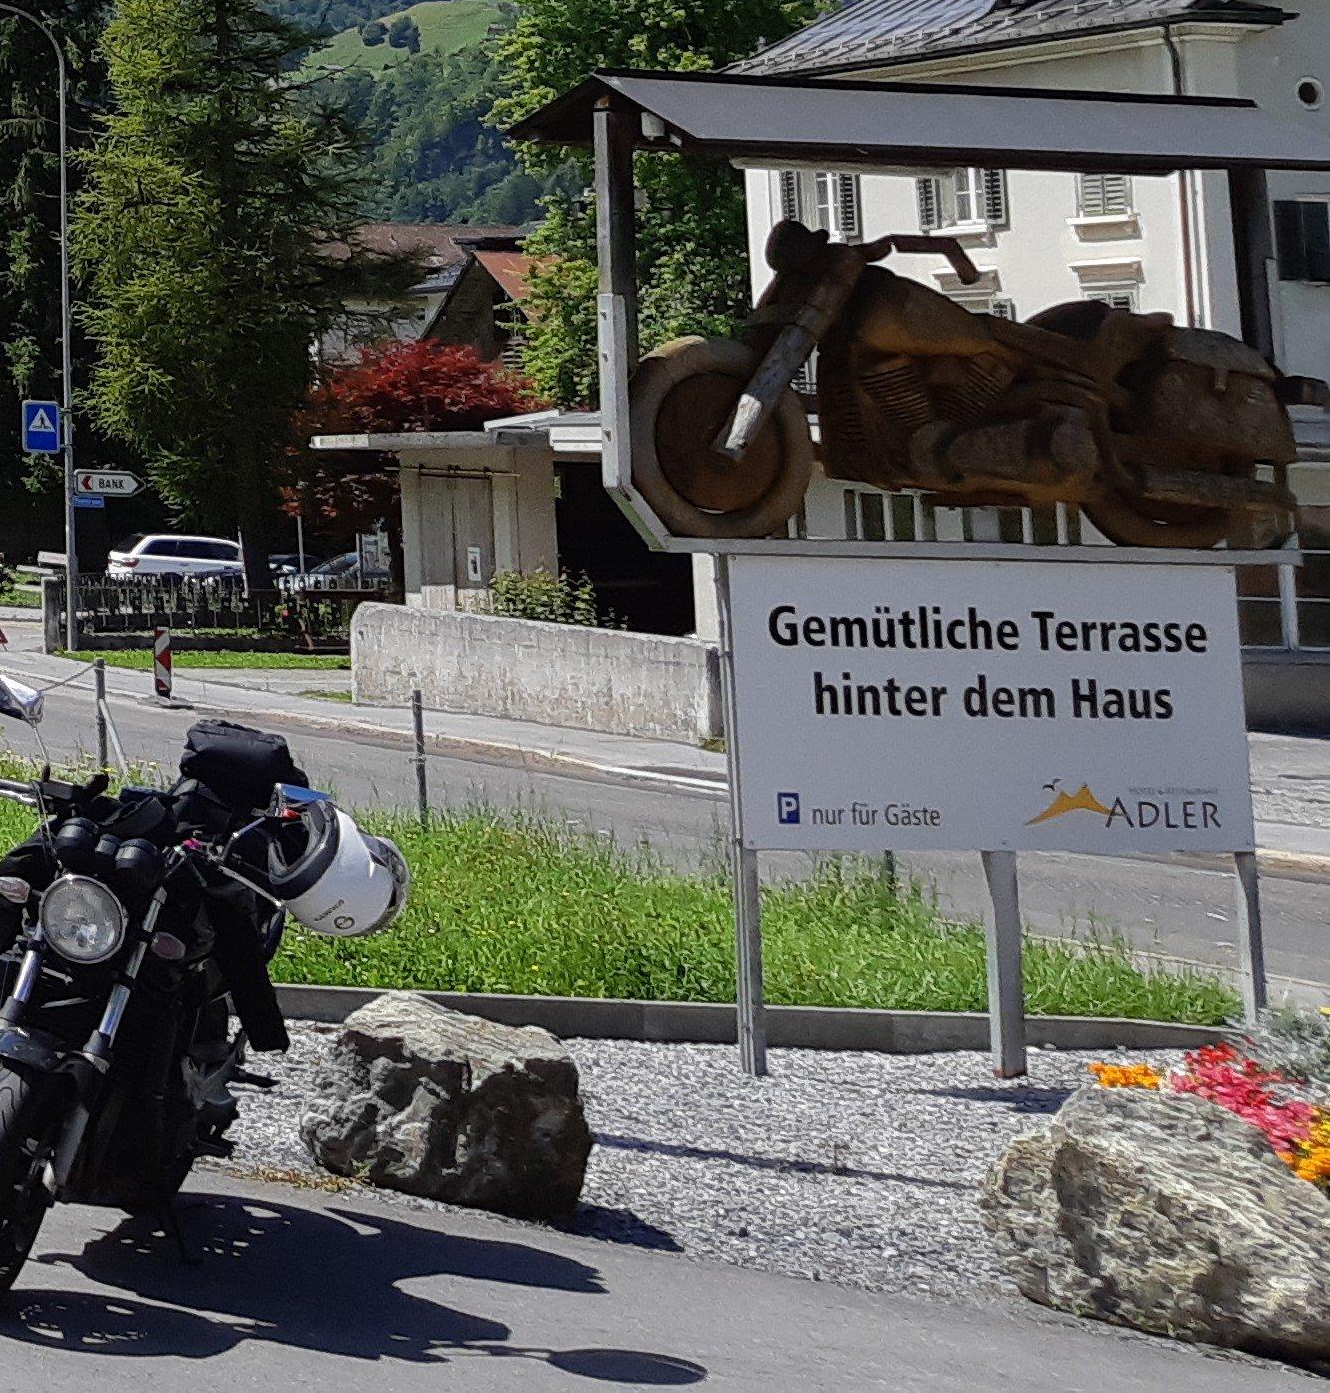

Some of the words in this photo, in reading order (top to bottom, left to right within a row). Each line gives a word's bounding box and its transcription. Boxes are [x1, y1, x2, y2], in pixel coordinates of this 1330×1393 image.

[98, 478, 125, 490] BANK
[767, 604, 1020, 650] Gemütliche
[1030, 610, 1208, 654] Terrasse
[812, 671, 948, 717] hinter
[963, 674, 1057, 719] dem
[1070, 678, 1174, 720] Haus
[812, 807, 845, 825] nur
[851, 801, 879, 826] für
[884, 803, 941, 826] Gäste
[1104, 796, 1222, 829] ADLER
